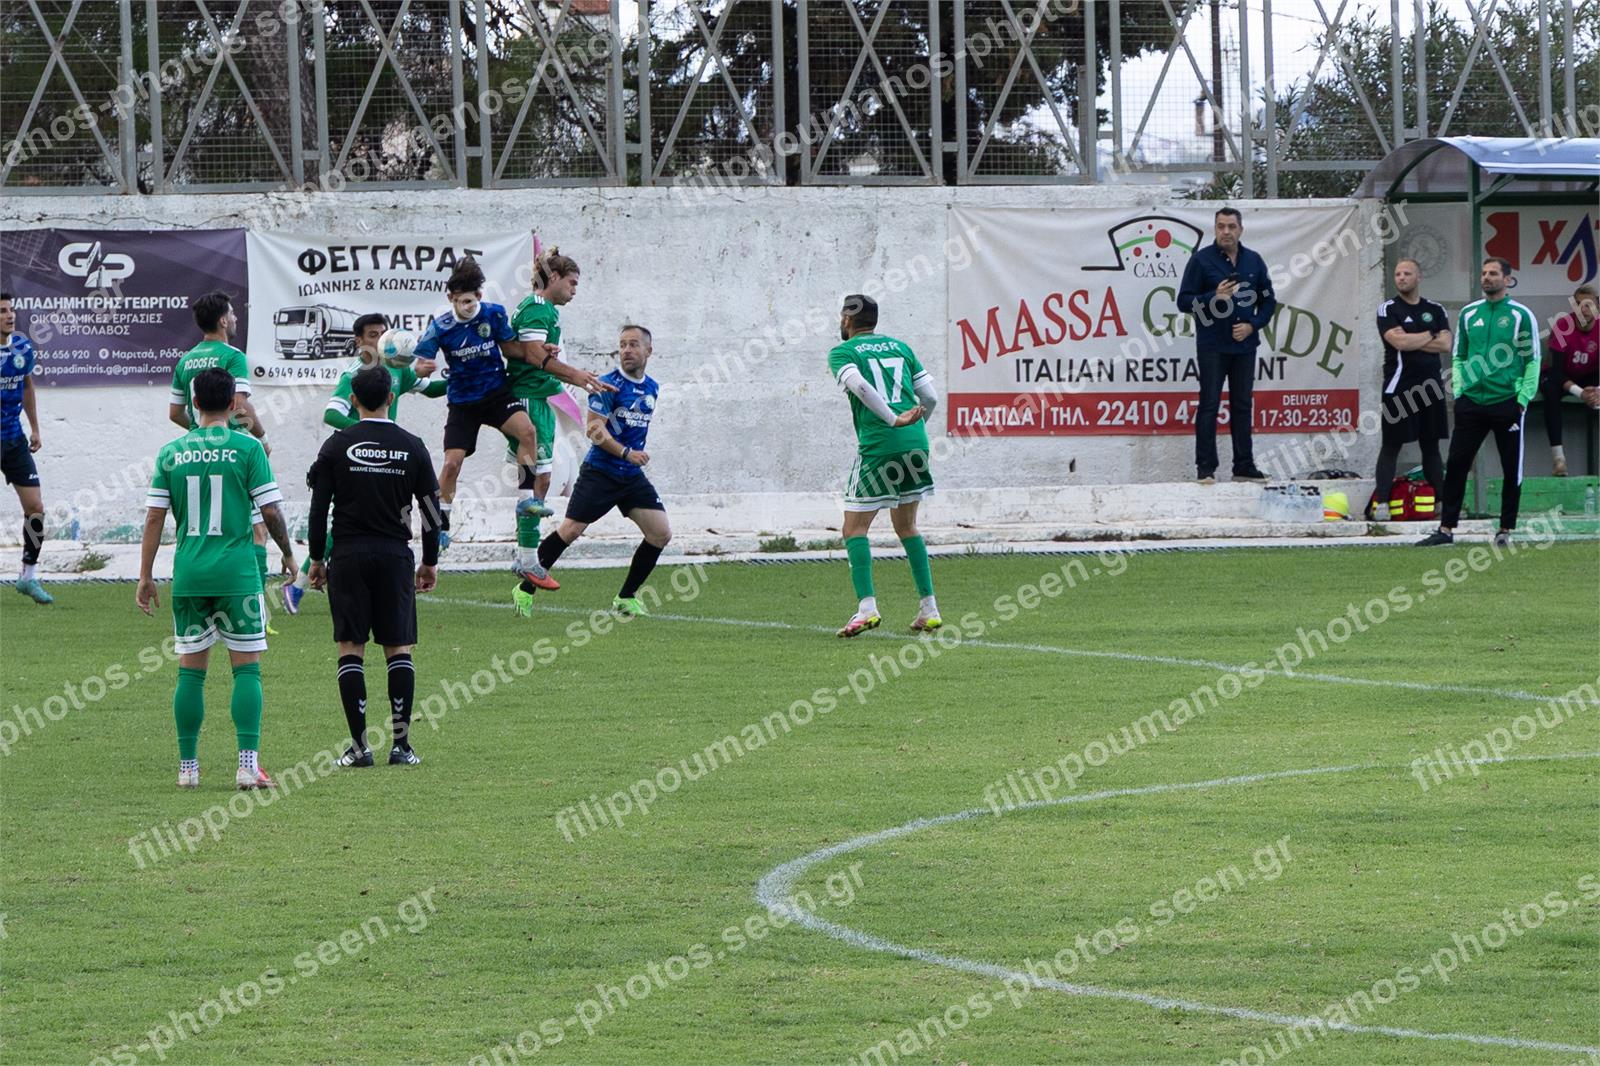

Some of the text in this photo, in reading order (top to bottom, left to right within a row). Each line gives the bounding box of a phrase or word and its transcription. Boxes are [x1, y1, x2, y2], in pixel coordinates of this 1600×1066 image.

[297, 245, 483, 275] ΦΕΓΓΑΡΑ
[1134, 262, 1178, 278] CASA
[298, 278, 450, 297] ΙΩΑΝΝΗΣ & ΚΩΝΣΤΑΝΤ
[124, 297, 189, 309] ΓΕΩΡΓΙΟΣ
[30, 313, 163, 324] ΟΙΚΟΔΟΜΙΚΕΣ ΕΡΓΑΣΙΕΣ
[63, 325, 131, 336] ΕΡΓΟΛΑΒΟΣ
[957, 286, 1353, 378] MASSA GNDE
[52, 350, 69, 360] 656
[72, 350, 90, 360] 920
[854, 343, 889, 353] RODOS
[1572, 351, 1588, 364] 30
[44, 364, 171, 376] papadimitris.g@gmail.com
[268, 367, 338, 379] 6949 694 129
[1015, 357, 1287, 383] ITALIAN RESTANT
[868, 357, 905, 404] 17
[1282, 394, 1329, 405] DELIVERY
[957, 407, 1035, 426] ΠΑΣΤΙΔΑ
[1050, 406, 1090, 426] ΤΗΛ.
[1096, 400, 1168, 426] 22410
[1260, 409, 1352, 427] 17:30-23:30
[174, 449, 237, 465] RODOS FC
[355, 448, 409, 461] RODOS LIFT
[186, 474, 223, 537] 11
